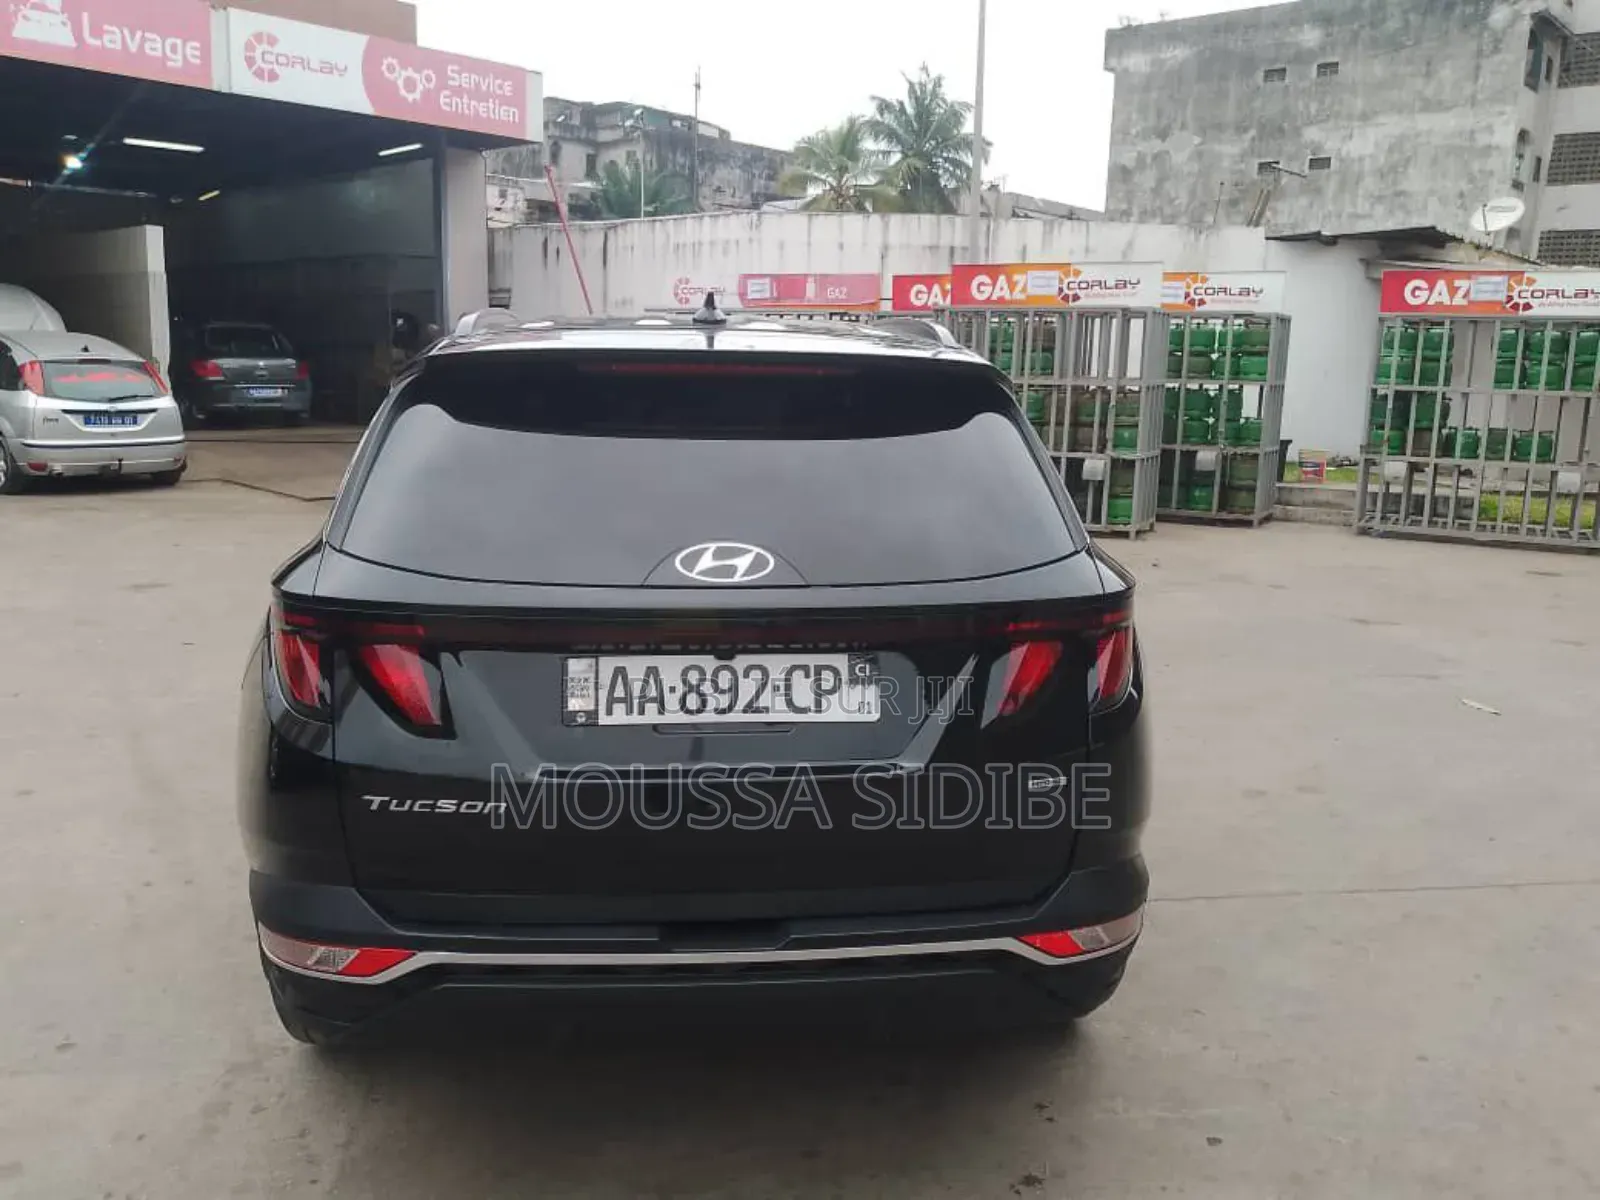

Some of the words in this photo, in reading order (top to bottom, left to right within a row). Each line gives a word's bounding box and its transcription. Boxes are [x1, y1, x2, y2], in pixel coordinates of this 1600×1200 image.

[82, 11, 201, 67] Lavage
[261, 49, 348, 76] CORLAY
[447, 65, 514, 97] Service
[440, 89, 519, 124] Entretien
[827, 286, 847, 299] GAZ
[970, 274, 1028, 301] GAZ
[1067, 277, 1140, 290] CORLAY
[1193, 285, 1264, 298] CORLAY
[1404, 279, 1471, 305] GAZ
